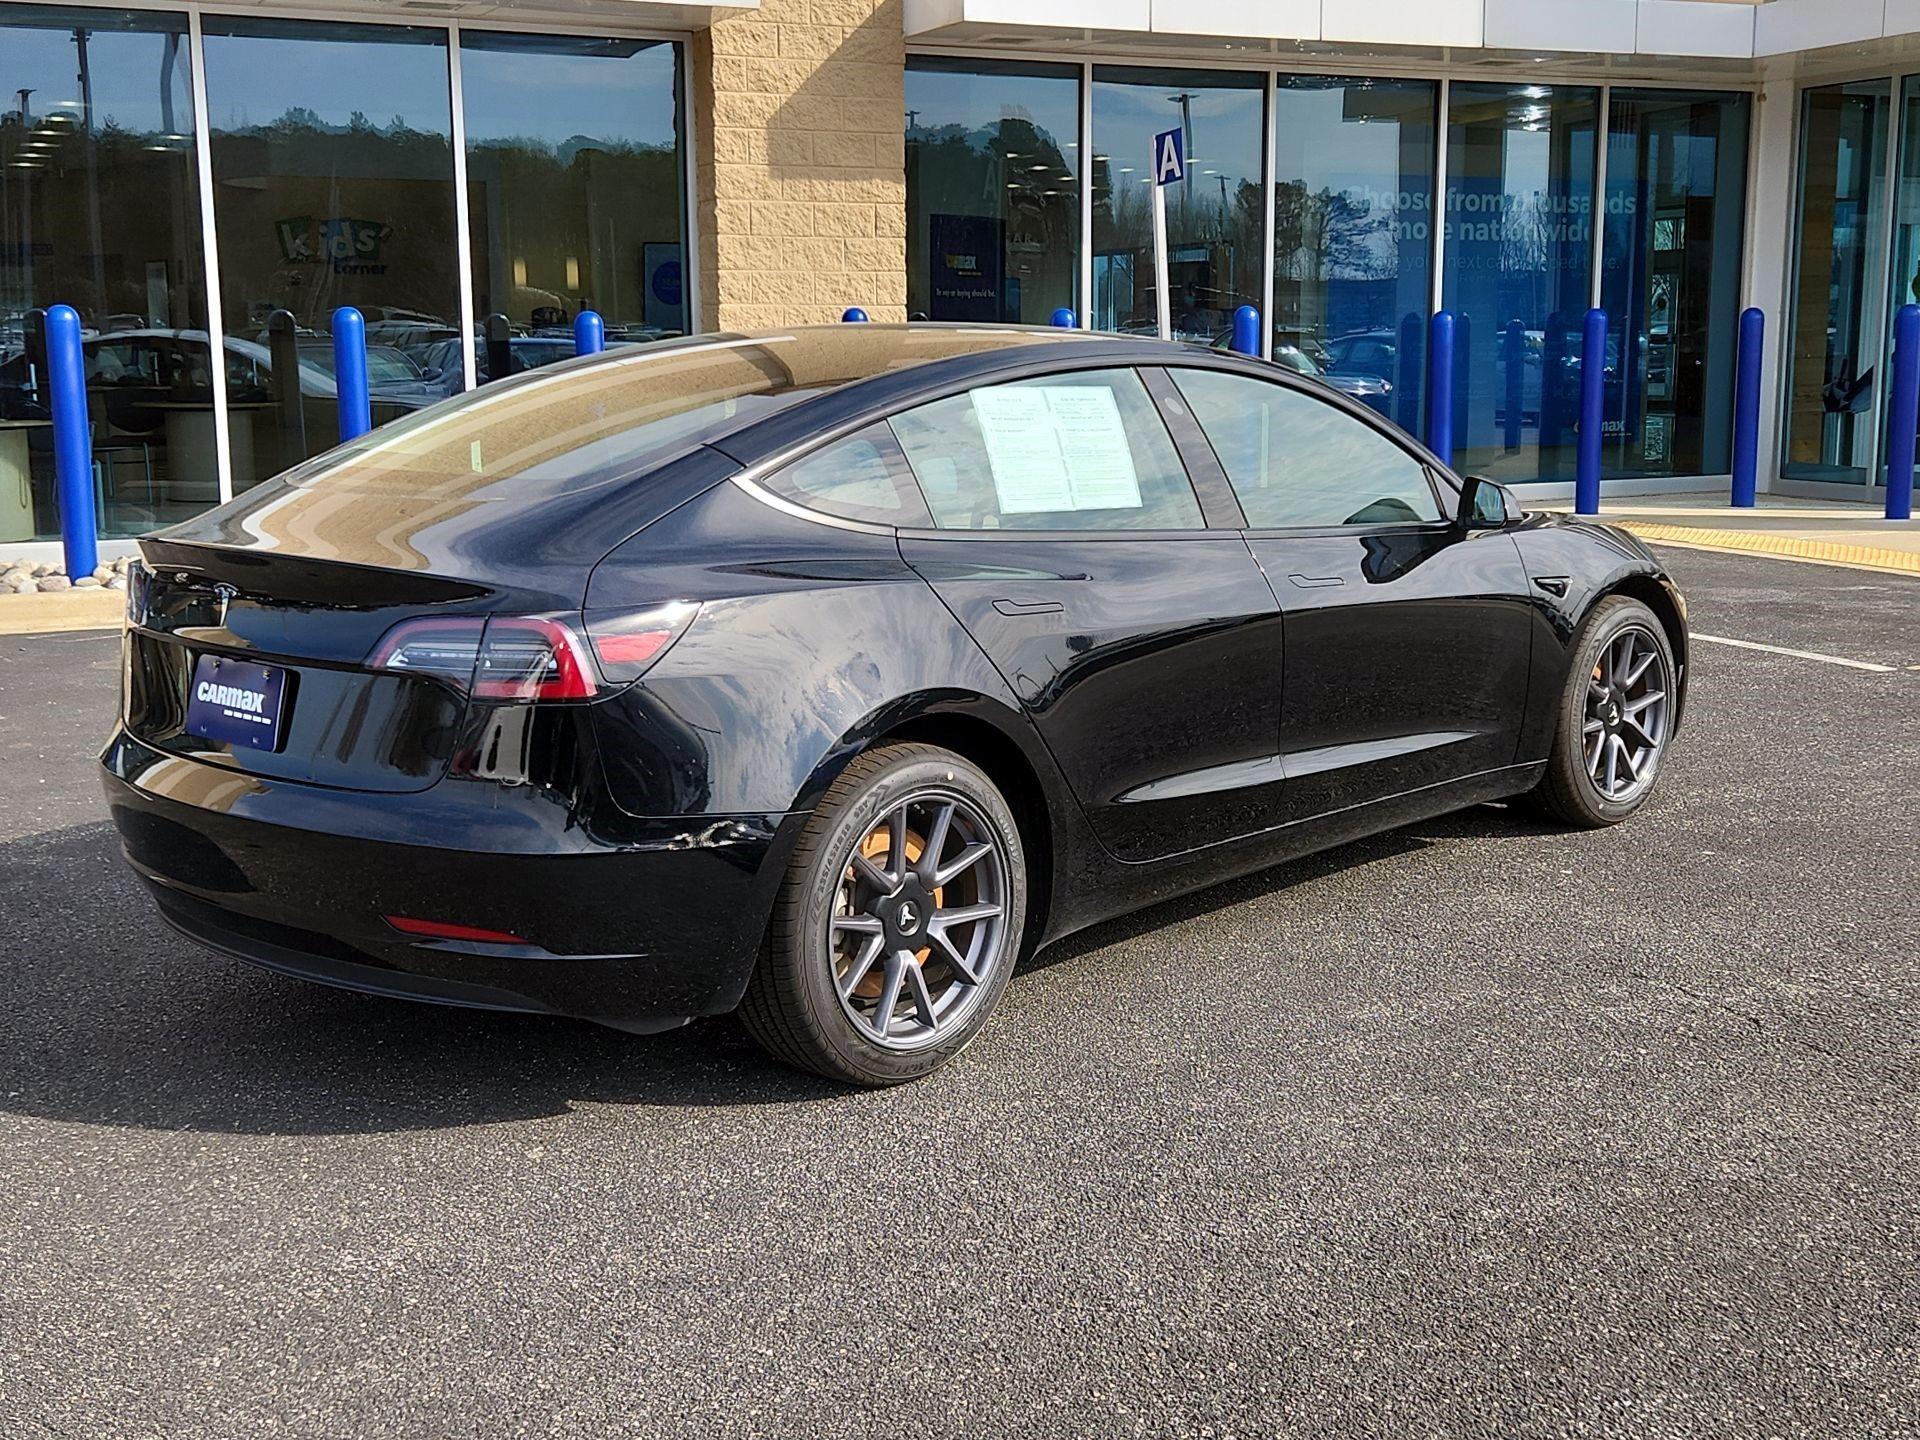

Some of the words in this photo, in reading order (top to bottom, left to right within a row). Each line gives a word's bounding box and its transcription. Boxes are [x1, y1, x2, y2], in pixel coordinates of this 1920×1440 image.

[1160, 134, 1181, 182] A
[1446, 187, 1504, 212] from
[1511, 190, 1637, 214] ousads
[1388, 220, 1453, 241] moe
